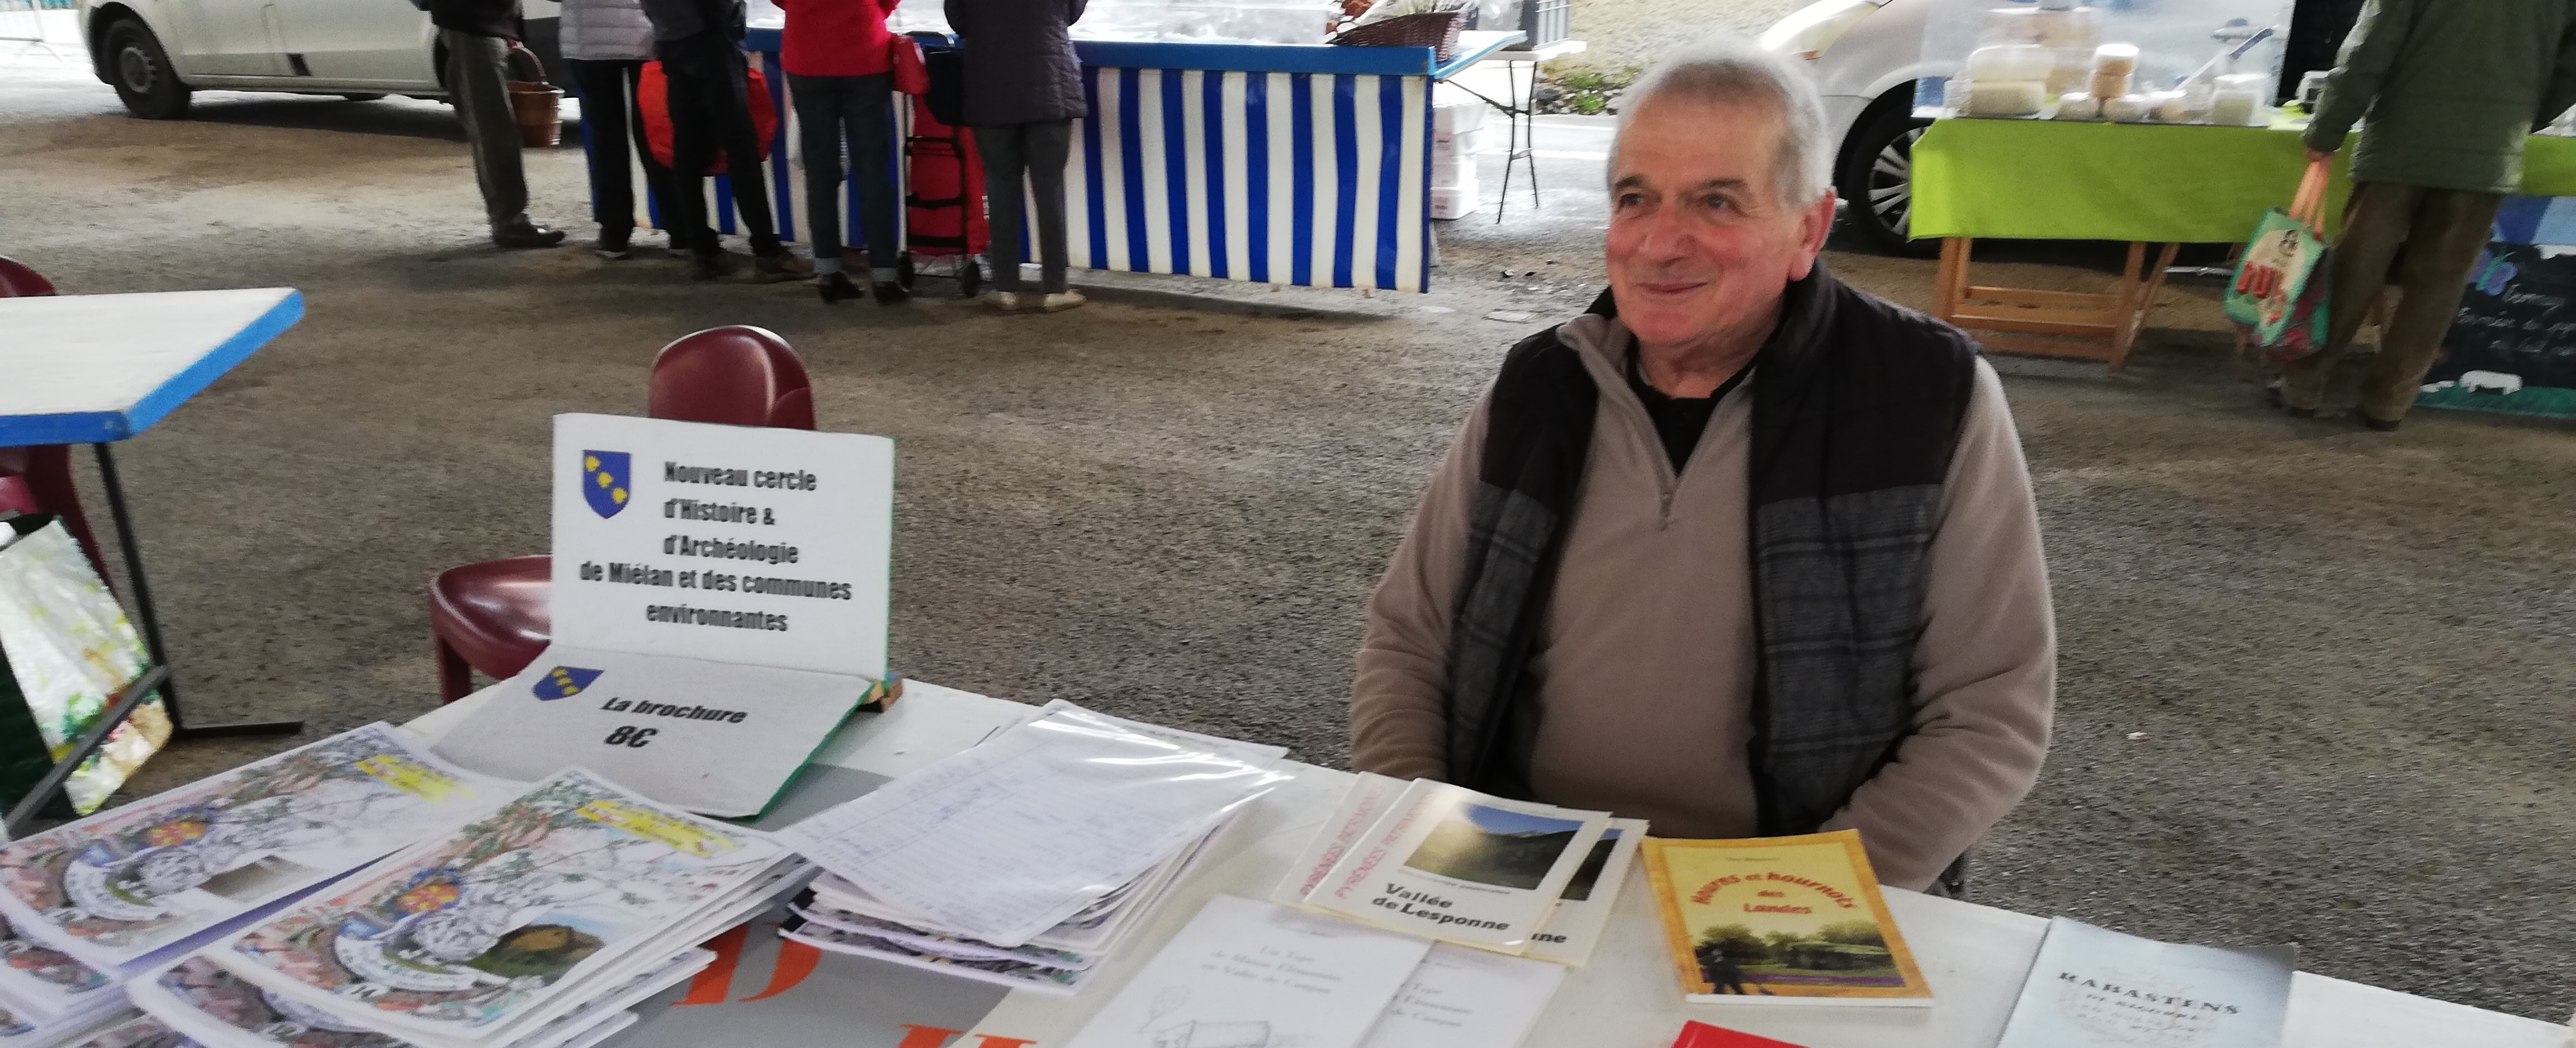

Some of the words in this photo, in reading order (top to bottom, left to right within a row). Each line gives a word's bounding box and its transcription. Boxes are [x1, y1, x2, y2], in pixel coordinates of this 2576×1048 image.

[664, 461, 748, 487] Nouveau
[754, 469, 817, 491] cercle
[664, 498, 757, 524] d'Histoire
[763, 507, 776, 526] &
[663, 534, 799, 564] d'Archéologie
[580, 560, 603, 581] de
[608, 561, 674, 587] Miélan
[678, 569, 697, 589] et
[701, 569, 737, 592] des
[742, 575, 853, 601] communes
[645, 603, 789, 632] environnantes
[599, 696, 629, 712] La
[633, 698, 749, 724] brochure
[1385, 882, 1453, 909] Vallée
[1371, 896, 1399, 910] de
[1399, 903, 1512, 931] Lesponne
[2057, 971, 2239, 1015] RABASTENS
